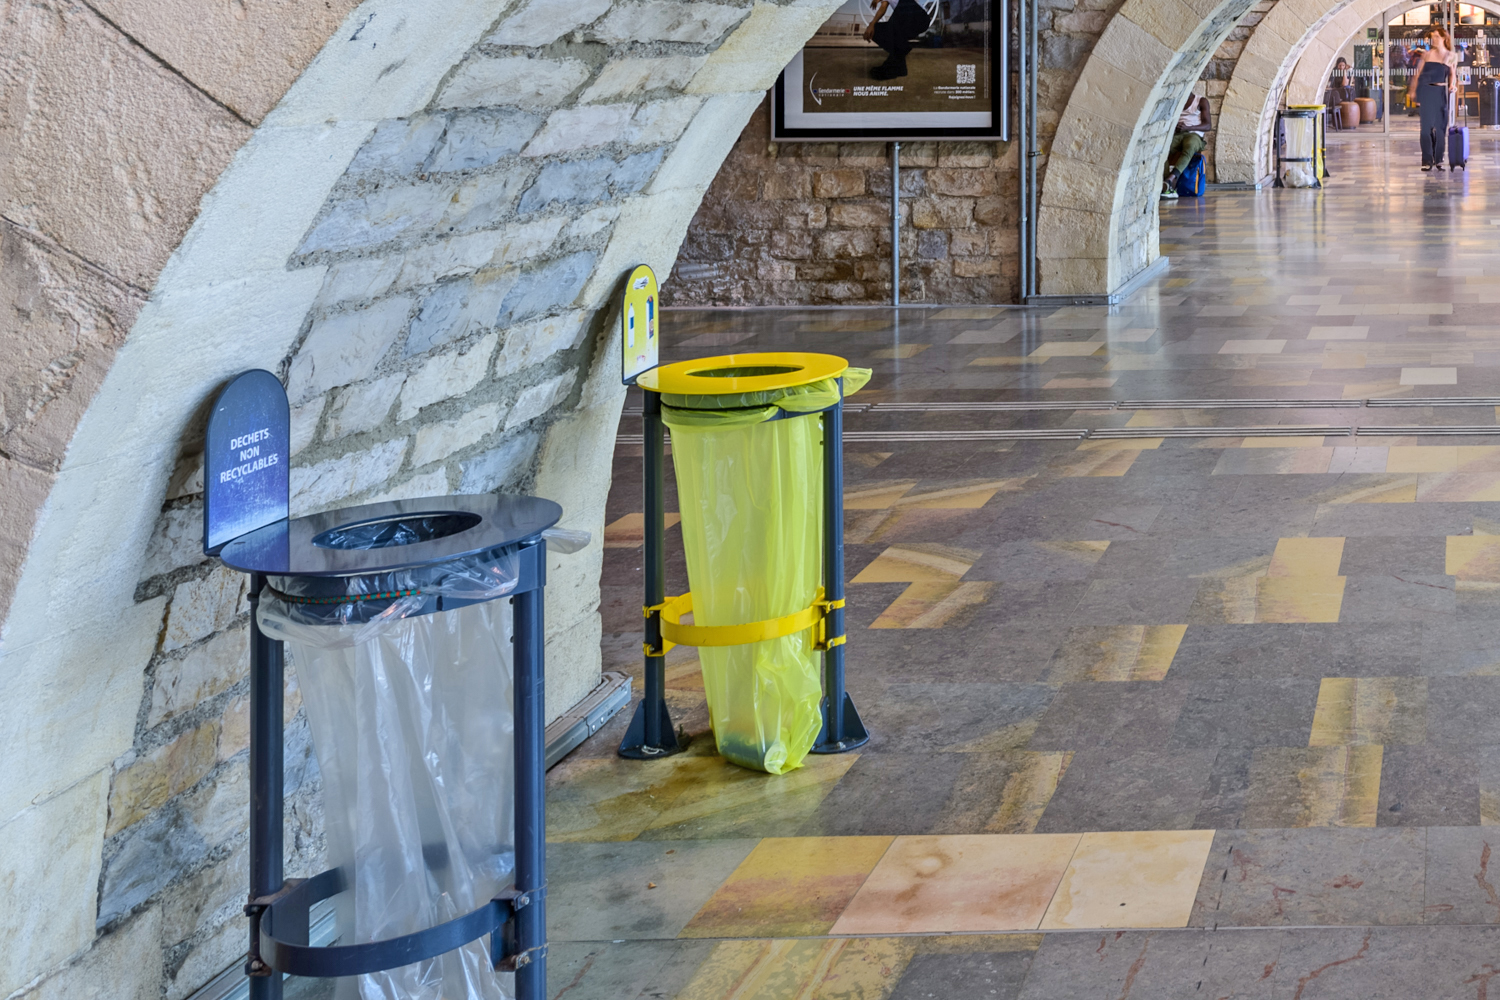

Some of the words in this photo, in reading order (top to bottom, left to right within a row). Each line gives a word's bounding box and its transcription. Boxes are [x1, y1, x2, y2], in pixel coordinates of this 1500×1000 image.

[230, 427, 269, 450] DECHETS
[240, 445, 260, 462] NON
[220, 453, 279, 484] RECYCLABLES
